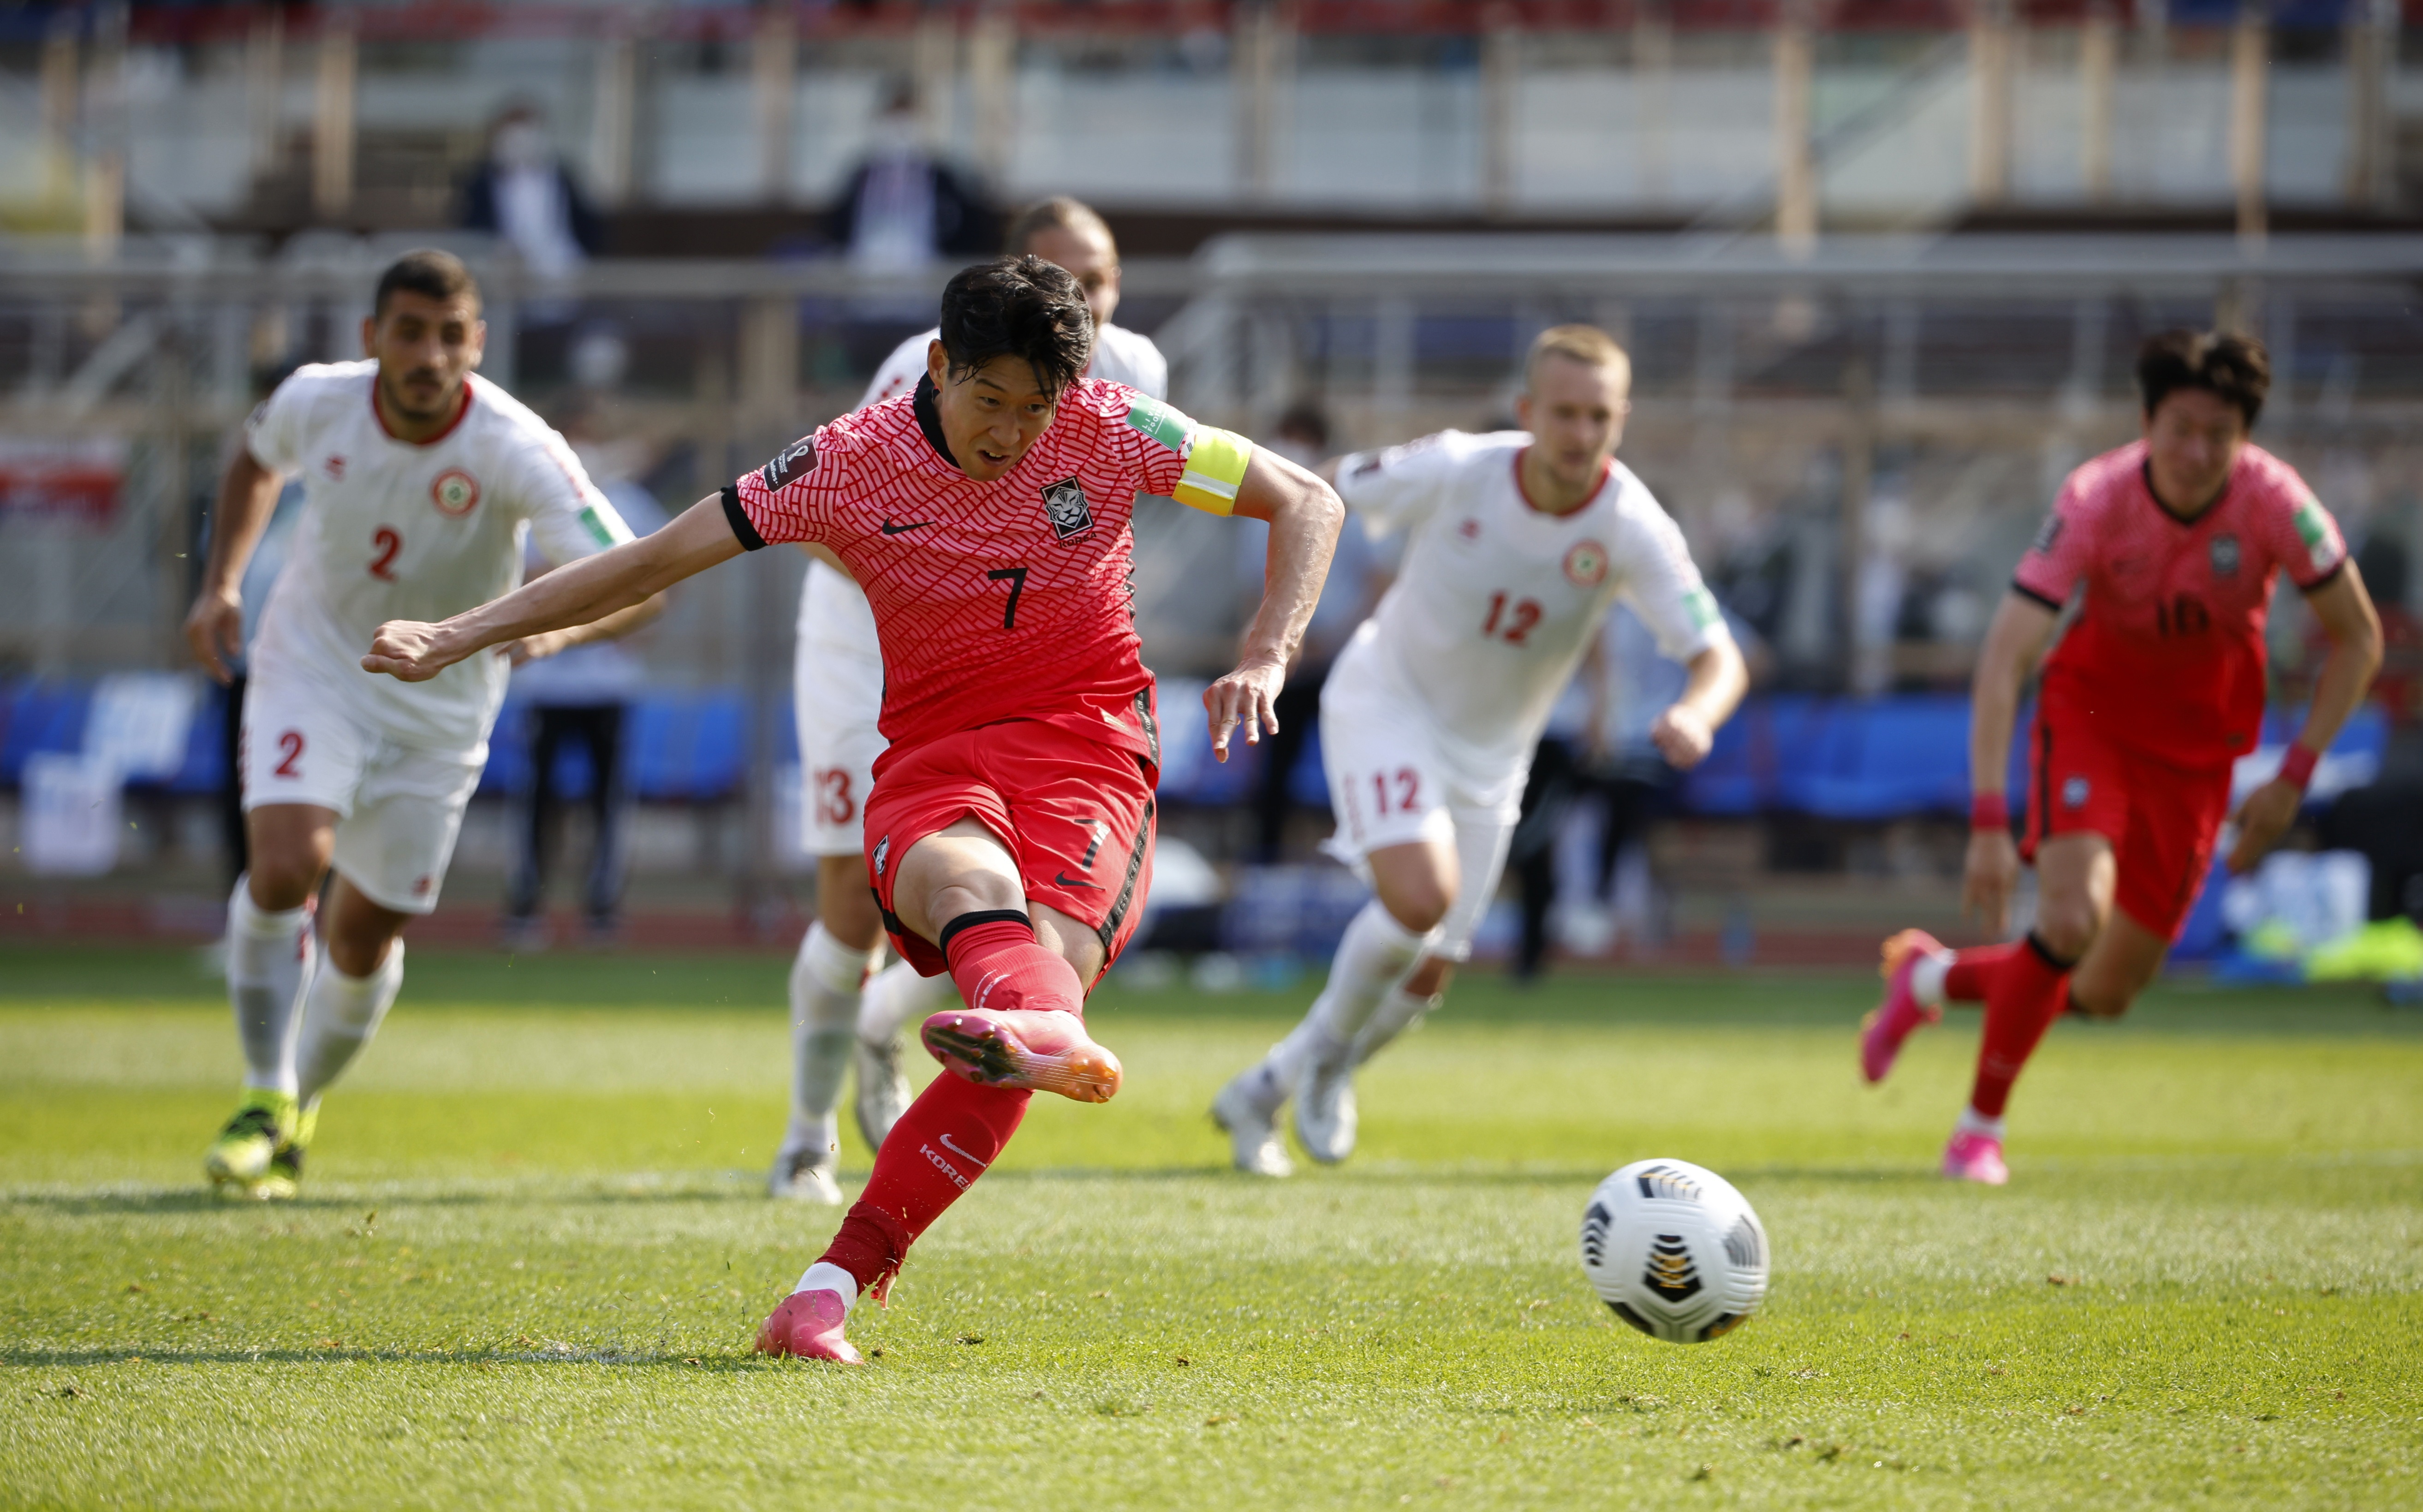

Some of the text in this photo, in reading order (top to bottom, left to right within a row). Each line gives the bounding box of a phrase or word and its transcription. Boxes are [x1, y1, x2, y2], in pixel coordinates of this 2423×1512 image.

[369, 526, 401, 583] 2
[1059, 532, 1097, 548] KOREA
[988, 567, 1029, 629] 7
[1483, 590, 1542, 645] 12
[274, 730, 304, 778] 2
[814, 768, 856, 825] 13
[1374, 768, 1420, 815] 12
[1074, 819, 1111, 873] 7
